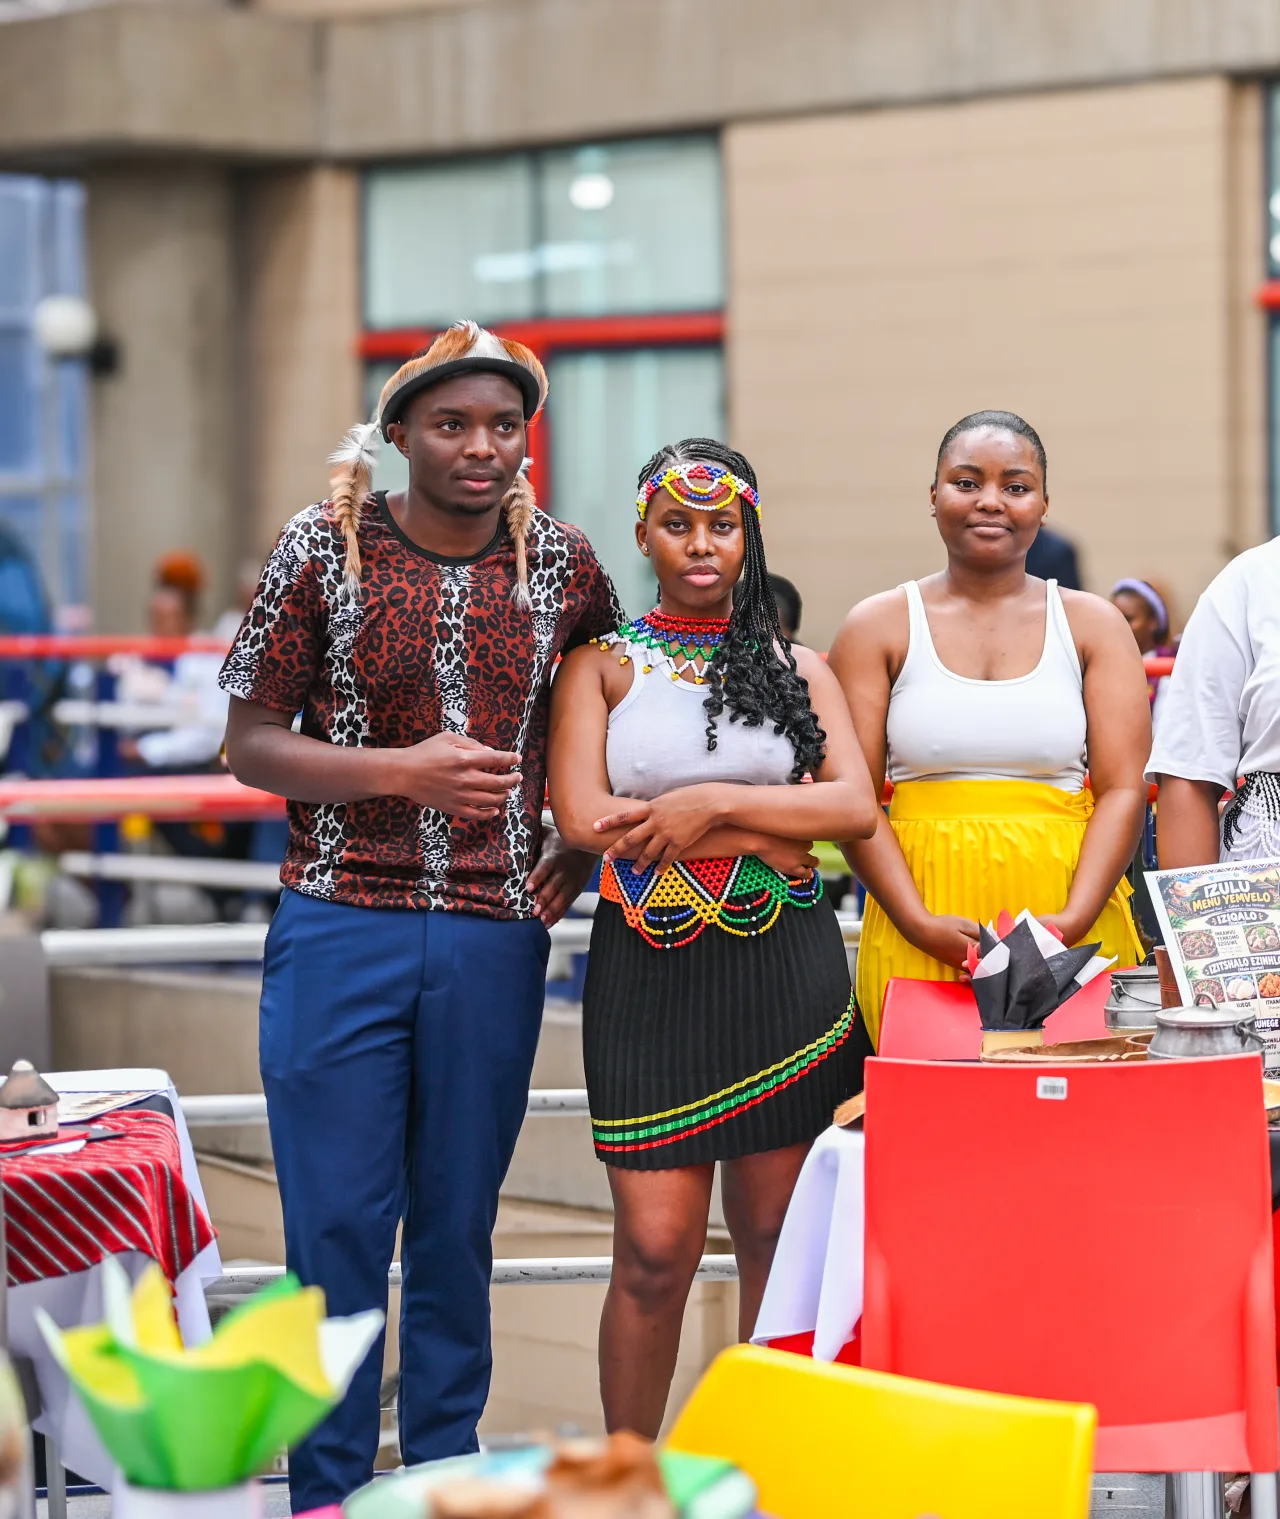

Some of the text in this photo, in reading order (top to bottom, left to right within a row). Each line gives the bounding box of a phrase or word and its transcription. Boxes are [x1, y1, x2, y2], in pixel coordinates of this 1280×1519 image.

[1204, 881, 1250, 898] IZULU
[1192, 891, 1271, 912] MENU YEMVELO
[1216, 911, 1258, 925] IZIQALO
[1208, 958, 1249, 975] IZITSHALO
